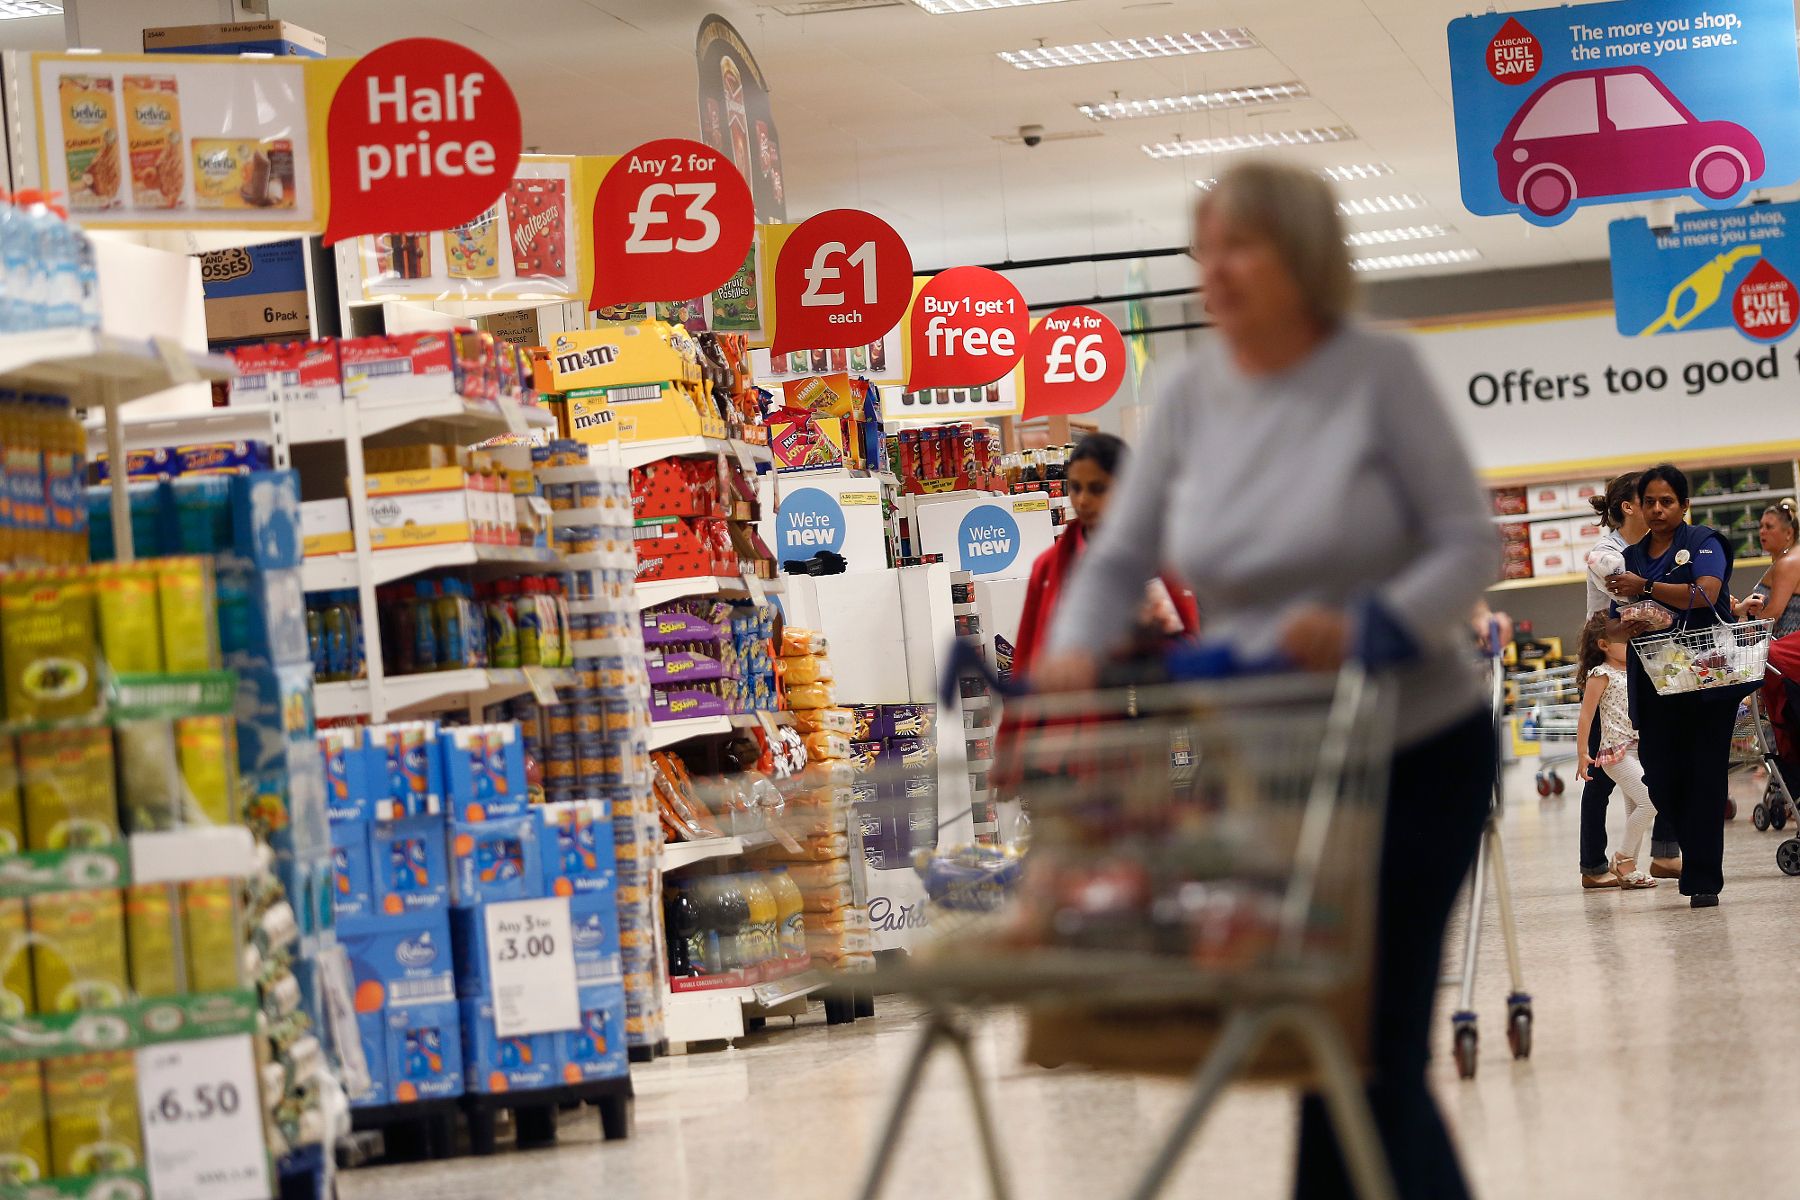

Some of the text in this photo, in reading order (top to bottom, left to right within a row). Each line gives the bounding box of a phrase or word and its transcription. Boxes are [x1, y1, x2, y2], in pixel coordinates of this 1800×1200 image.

[1569, 13, 1742, 42] The more you shop,
[1493, 36, 1532, 47] CLUBCARD
[1571, 32, 1738, 61] the more you save.
[1494, 46, 1534, 62] FUEL
[1495, 58, 1535, 76] SAVE
[366, 72, 485, 125] Half
[71, 103, 107, 121] belvita
[135, 104, 171, 122] belvita
[357, 130, 497, 192] price
[628, 153, 716, 177] Any 2 for
[625, 182, 721, 254] £3
[1683, 209, 1787, 232] more you shop,
[514, 204, 560, 257] Maltesers
[1656, 225, 1786, 250] the more you save.
[205, 255, 223, 265] AND
[801, 241, 878, 307] £1
[717, 285, 750, 300] Pastilles
[1740, 280, 1790, 295] CLUBCARD
[924, 296, 1015, 317] Buy 1 get 1
[1742, 290, 1787, 311] FUEL
[263, 306, 298, 323] 6 Pack
[828, 309, 863, 324] each
[1045, 315, 1102, 333] Any 4 for
[1743, 300, 1792, 328] SAVE
[924, 316, 1016, 357] free
[1043, 333, 1108, 384] £6
[1467, 343, 1780, 407] Offers too good
[796, 378, 819, 401] HARIBO
[788, 511, 830, 528] We're
[785, 527, 836, 546] new
[968, 524, 1007, 542] We're
[967, 538, 1012, 558] new
[498, 918, 521, 934] Any
[525, 914, 535, 932] 3
